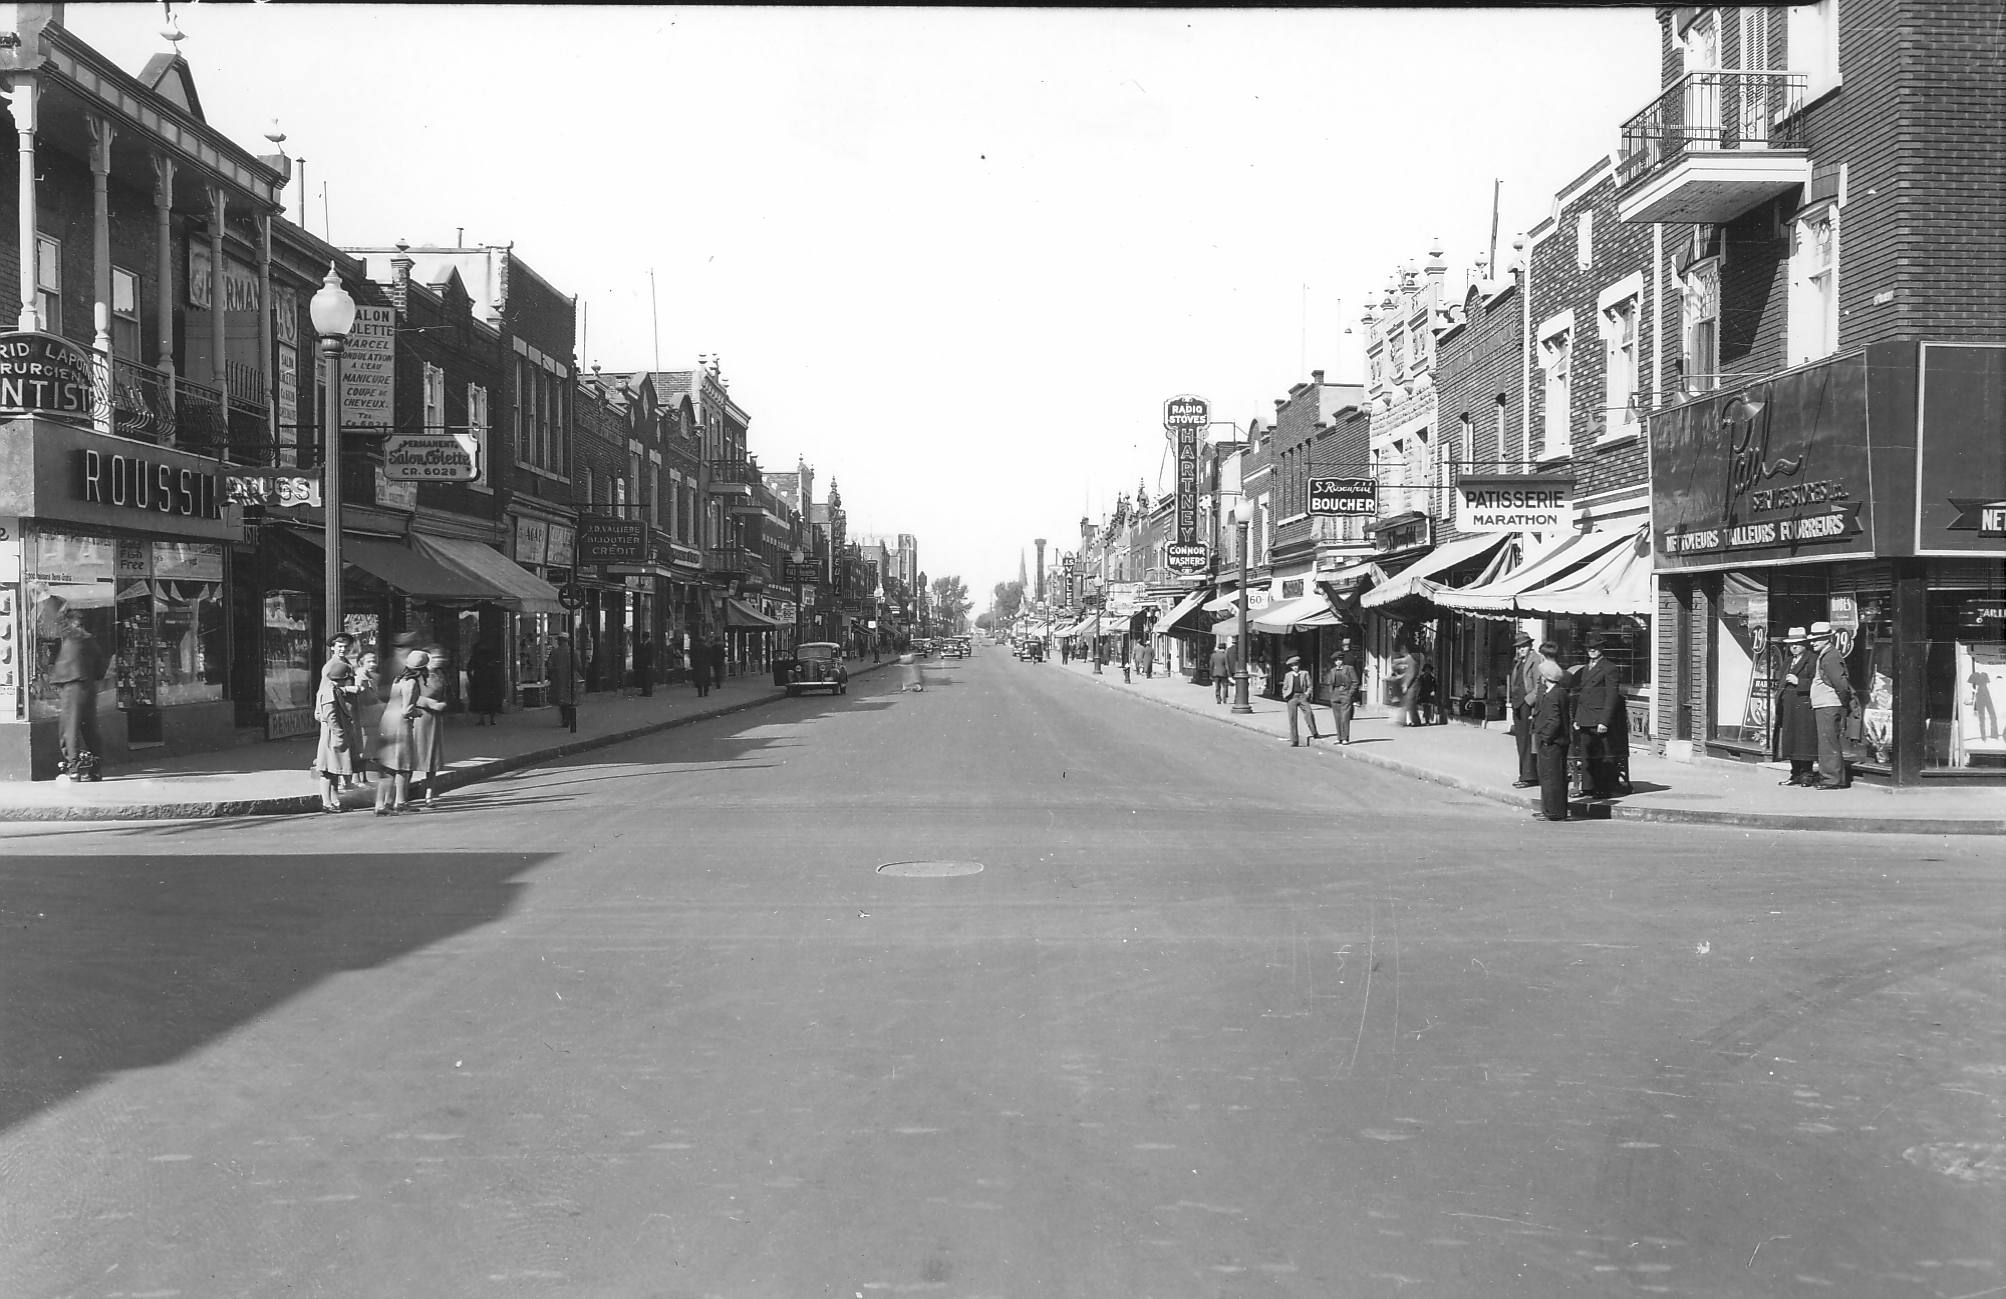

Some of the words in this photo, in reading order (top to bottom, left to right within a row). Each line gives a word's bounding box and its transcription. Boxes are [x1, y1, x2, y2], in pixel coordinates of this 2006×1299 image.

[354, 309, 390, 322] ALON
[350, 323, 394, 337] OLETTE
[342, 373, 392, 385] MANICURE
[346, 387, 376, 397] COUPE
[1171, 405, 1203, 415] RADIO
[1169, 415, 1206, 424] STOVES
[424, 467, 457, 476] 6028
[1180, 428, 1195, 543] HARTNEY
[1311, 497, 1375, 512] BOUCHER
[1465, 490, 1565, 509] PATISSERIE
[1473, 514, 1557, 526] MARATHON
[1723, 523, 1776, 547] TAILLEURS
[1780, 513, 1844, 541] FOURREURS
[1169, 546, 1206, 556] CONNOR
[121, 559, 144, 570] Free
[1169, 556, 1206, 566] WASHERS
